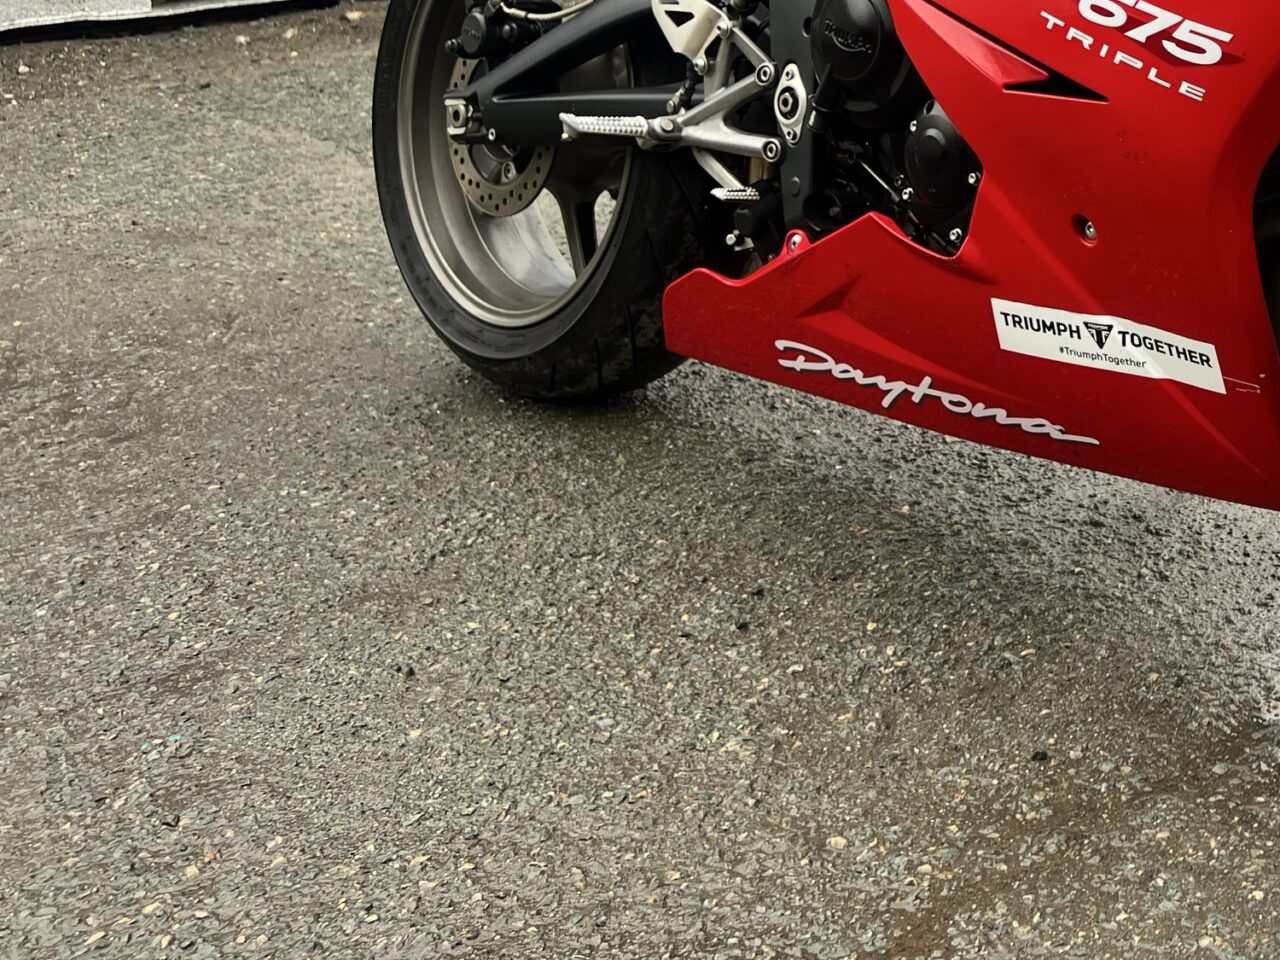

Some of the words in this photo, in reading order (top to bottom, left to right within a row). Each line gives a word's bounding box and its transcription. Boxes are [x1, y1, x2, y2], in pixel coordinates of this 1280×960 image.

[1039, 10, 1207, 102] TRIPLE
[999, 311, 1082, 340] TRIUMPH
[1117, 330, 1213, 368] TOGETHER
[1058, 346, 1147, 368] #TriumphTogether
[775, 339, 1100, 445] Daytona
